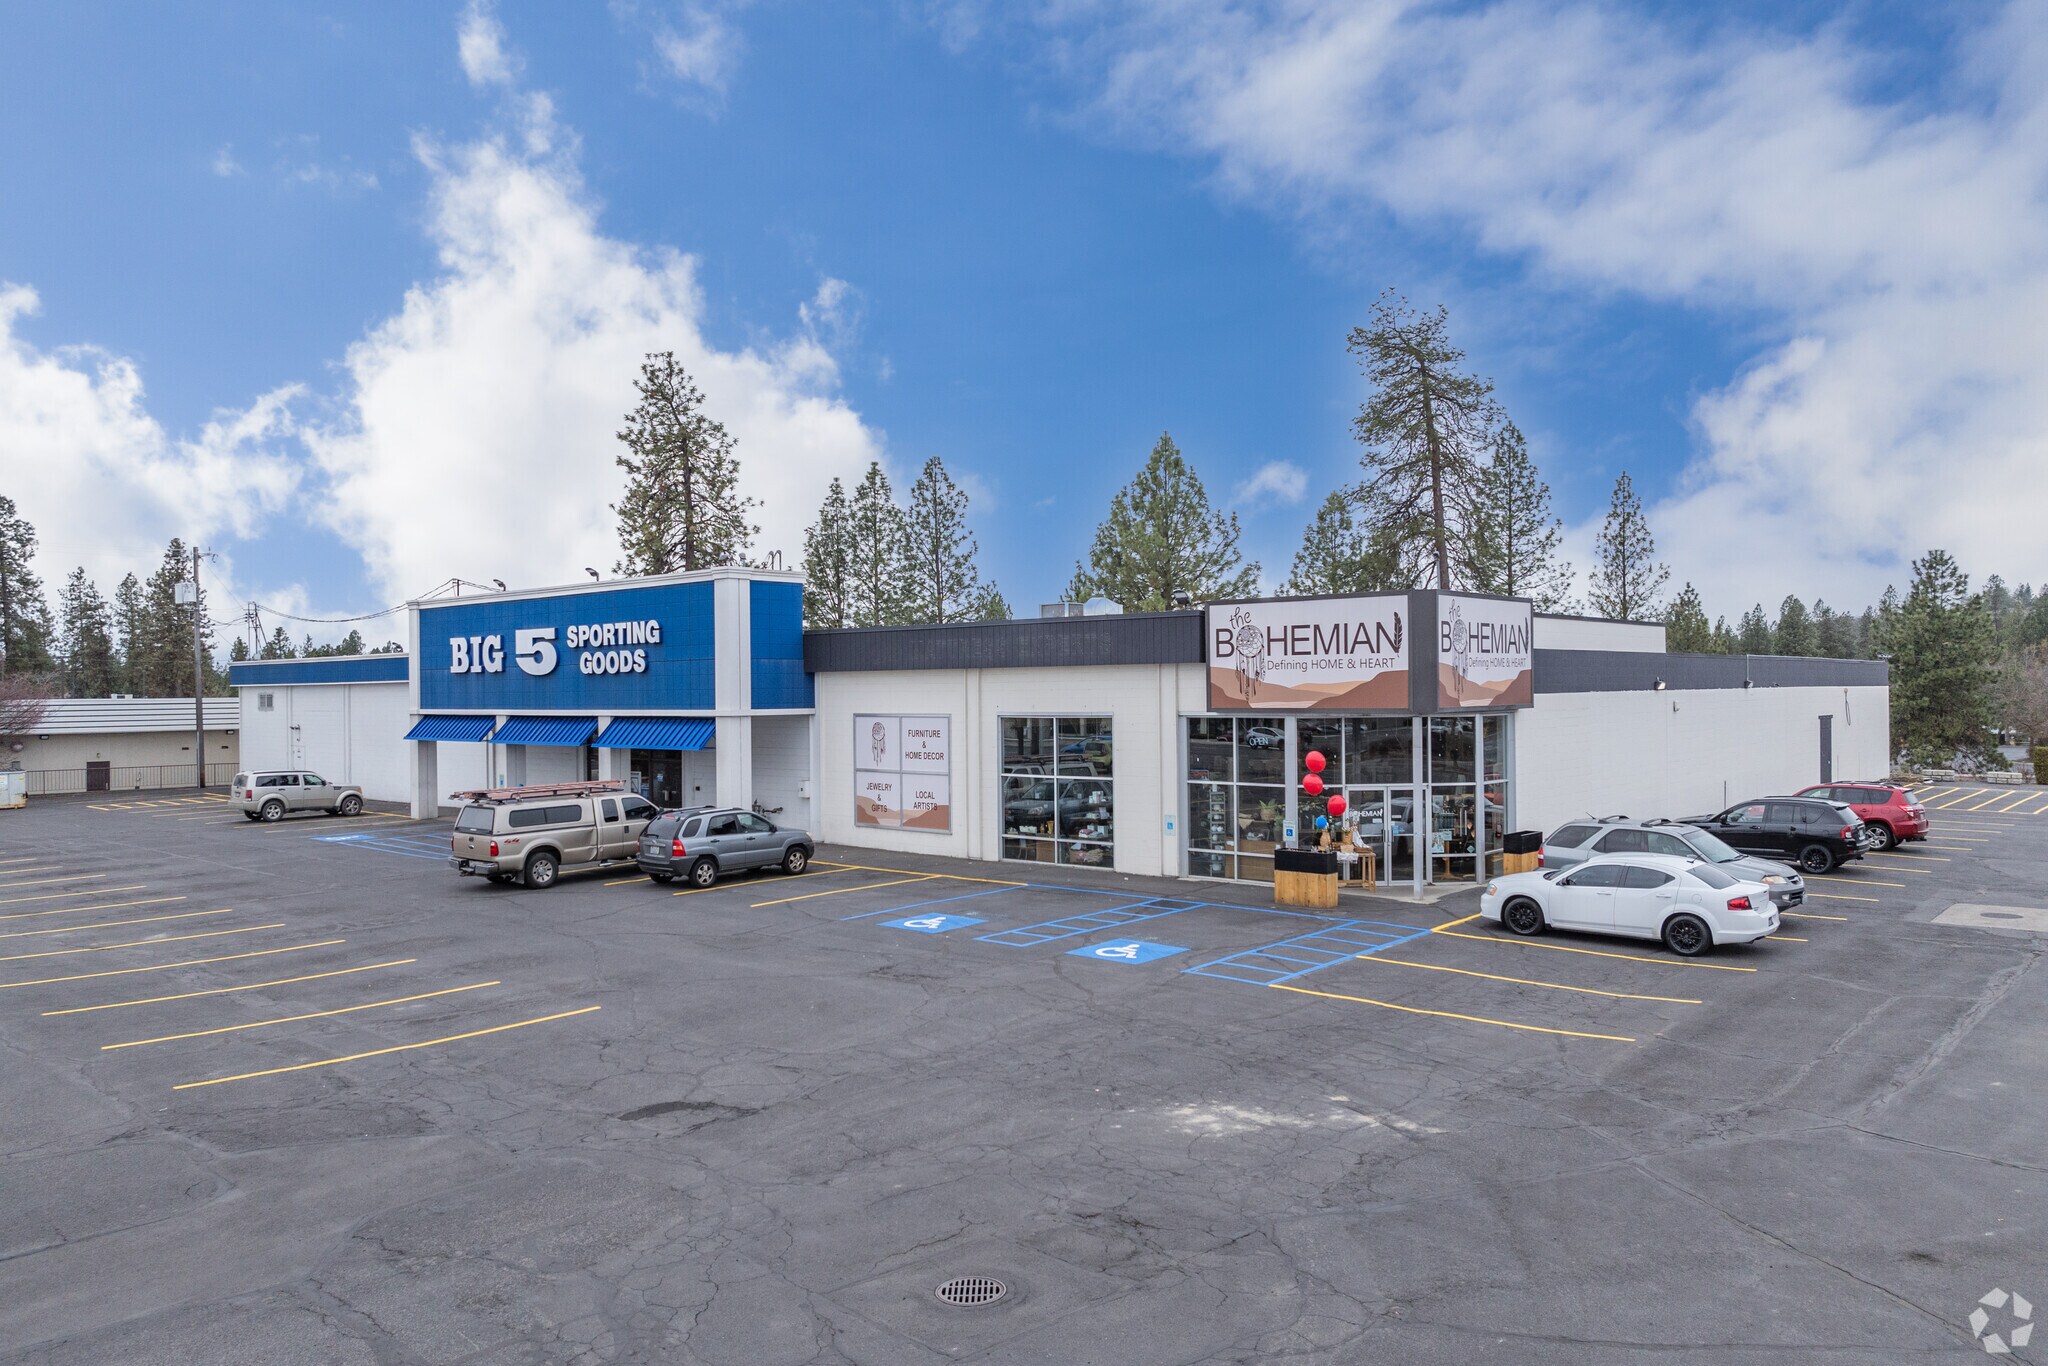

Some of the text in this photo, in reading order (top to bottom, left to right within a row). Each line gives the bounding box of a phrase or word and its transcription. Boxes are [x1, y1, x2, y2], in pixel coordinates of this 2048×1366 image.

[1229, 606, 1252, 630] the
[566, 619, 661, 648] SPORTING
[450, 628, 557, 676] BIG 5
[579, 649, 647, 674] GOODS
[1267, 657, 1395, 672] Defining HOME & HEART
[1490, 657, 1505, 668] HOME
[1511, 657, 1526, 668] HEART
[908, 730, 941, 738] FURNITURE
[1249, 737, 1269, 746] OPEN
[905, 751, 944, 760] HOME DECOR
[866, 783, 892, 791] JEWELRY
[915, 791, 935, 799] LOCAL
[871, 804, 887, 812] GIFTS
[913, 802, 937, 811] ARTISTS
